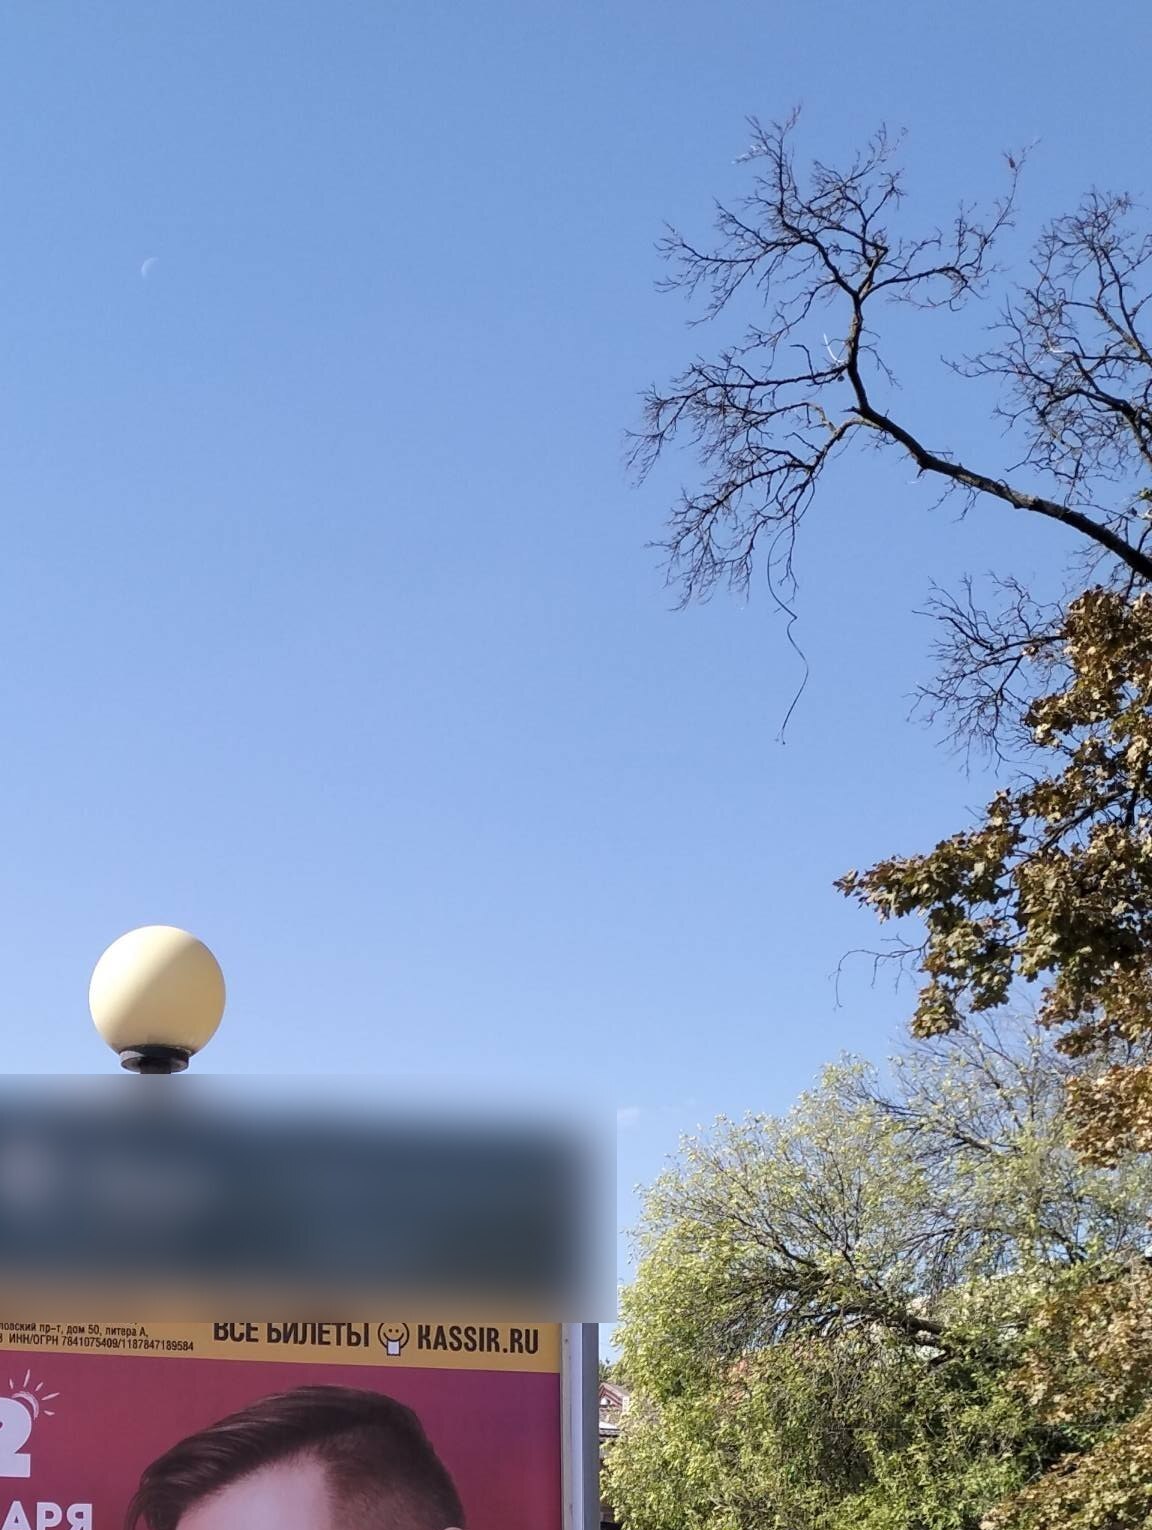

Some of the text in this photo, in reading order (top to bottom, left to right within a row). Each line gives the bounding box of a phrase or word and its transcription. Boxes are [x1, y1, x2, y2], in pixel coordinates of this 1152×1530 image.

[66, 1325, 85, 1335] дом
[88, 1324, 102, 1336] 50,
[105, 1326, 137, 1337] литера
[213, 1323, 539, 1355] ВСЕ БИЛЕТЫ KASSIR.RU
